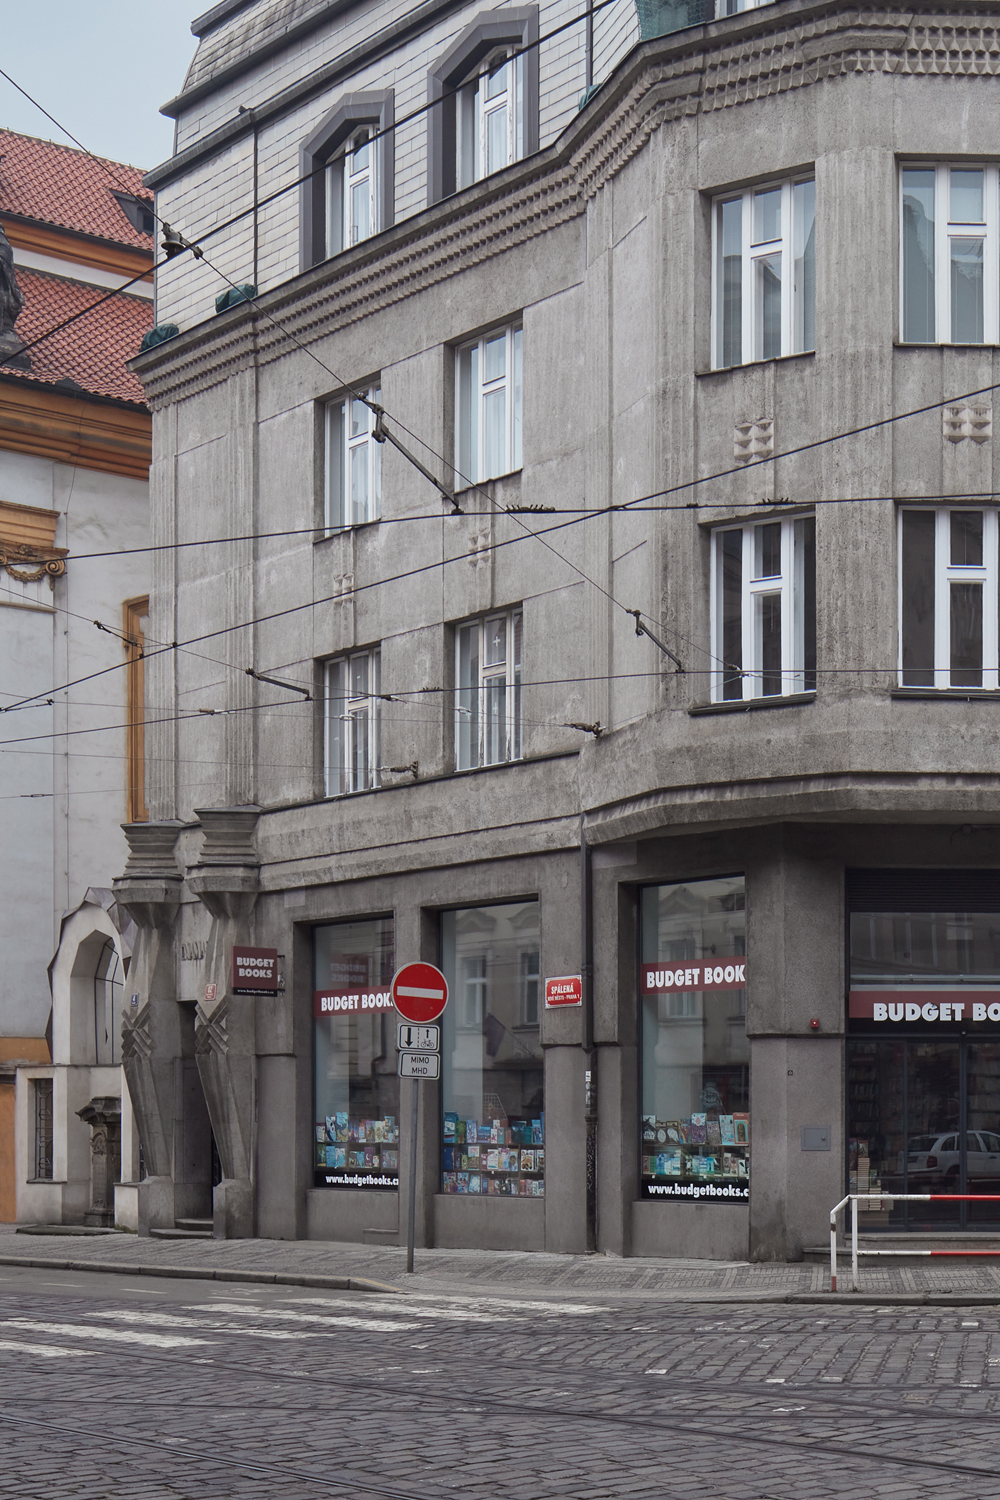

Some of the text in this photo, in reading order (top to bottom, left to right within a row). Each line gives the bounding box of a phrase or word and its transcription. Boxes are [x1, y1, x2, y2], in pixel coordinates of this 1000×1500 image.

[236, 956, 275, 968] BUDGET
[238, 968, 273, 978] BOOKS
[646, 968, 700, 989] BUDGET
[551, 982, 574, 995] SPÁLENÁ
[321, 994, 359, 1011] BUDGET
[873, 1002, 965, 1022] BUDGET
[410, 1056, 430, 1064] MIMO
[411, 1067, 428, 1075] MHD
